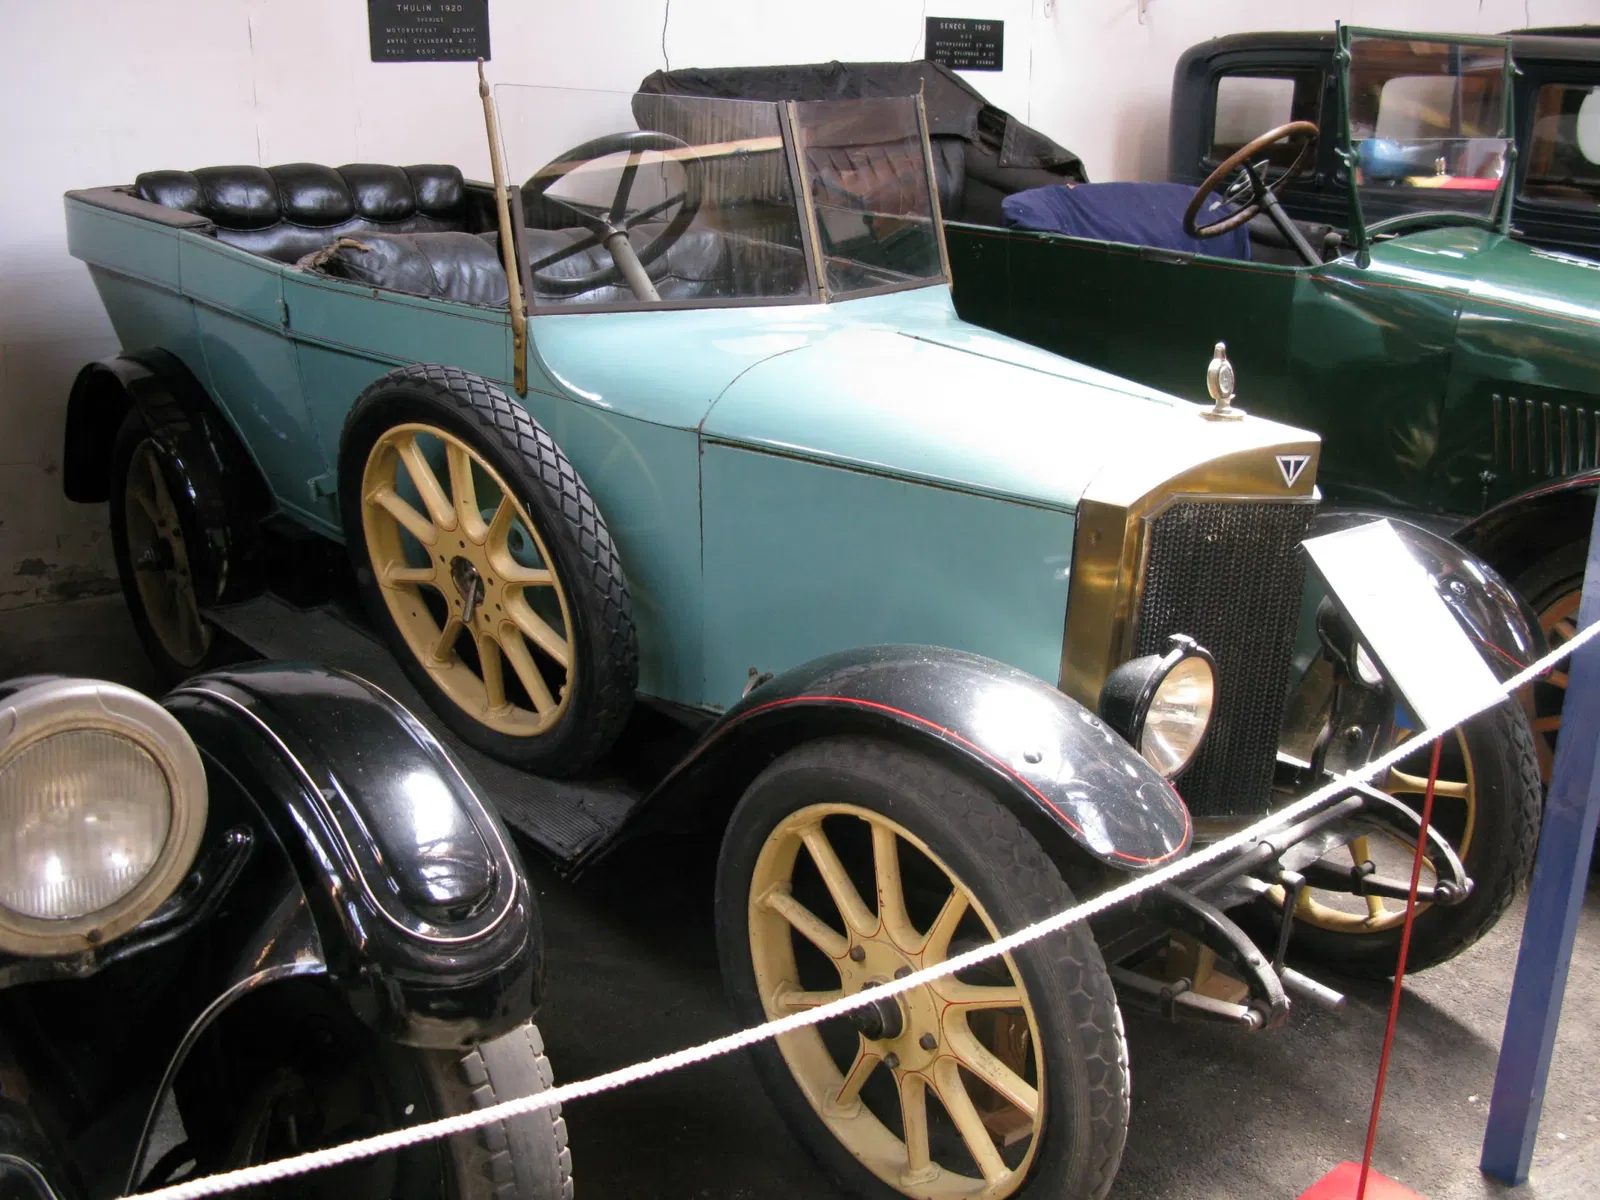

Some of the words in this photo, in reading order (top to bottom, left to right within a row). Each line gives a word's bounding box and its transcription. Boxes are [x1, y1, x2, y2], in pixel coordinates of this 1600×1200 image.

[396, 4, 432, 12] THULIN
[440, 4, 463, 12] 1920
[975, 23, 991, 31] 1920
